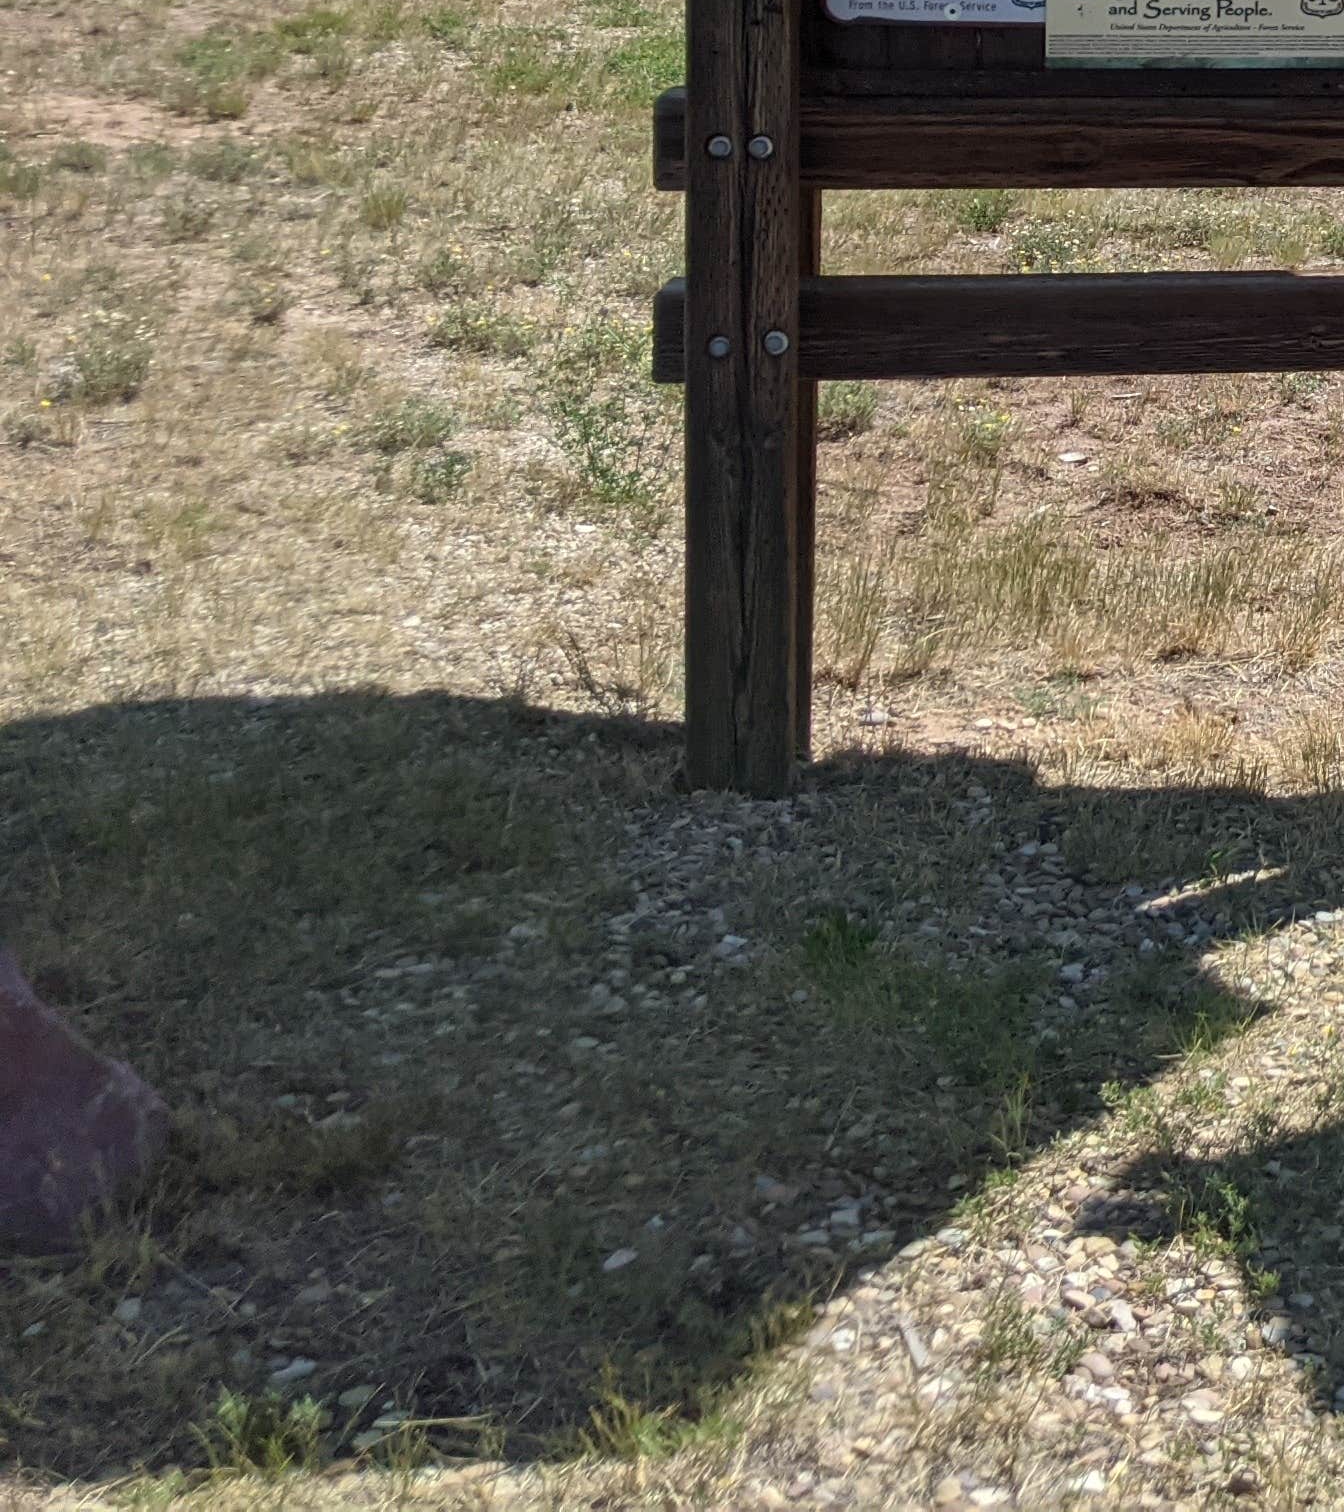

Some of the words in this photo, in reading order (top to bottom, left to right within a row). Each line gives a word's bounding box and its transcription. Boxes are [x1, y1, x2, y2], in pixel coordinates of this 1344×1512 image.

[877, 0, 895, 10] the
[899, 1, 919, 11] U.S.
[923, 1, 956, 12] Fore
[959, 1, 997, 12] Service
[1108, 3, 1138, 17] and
